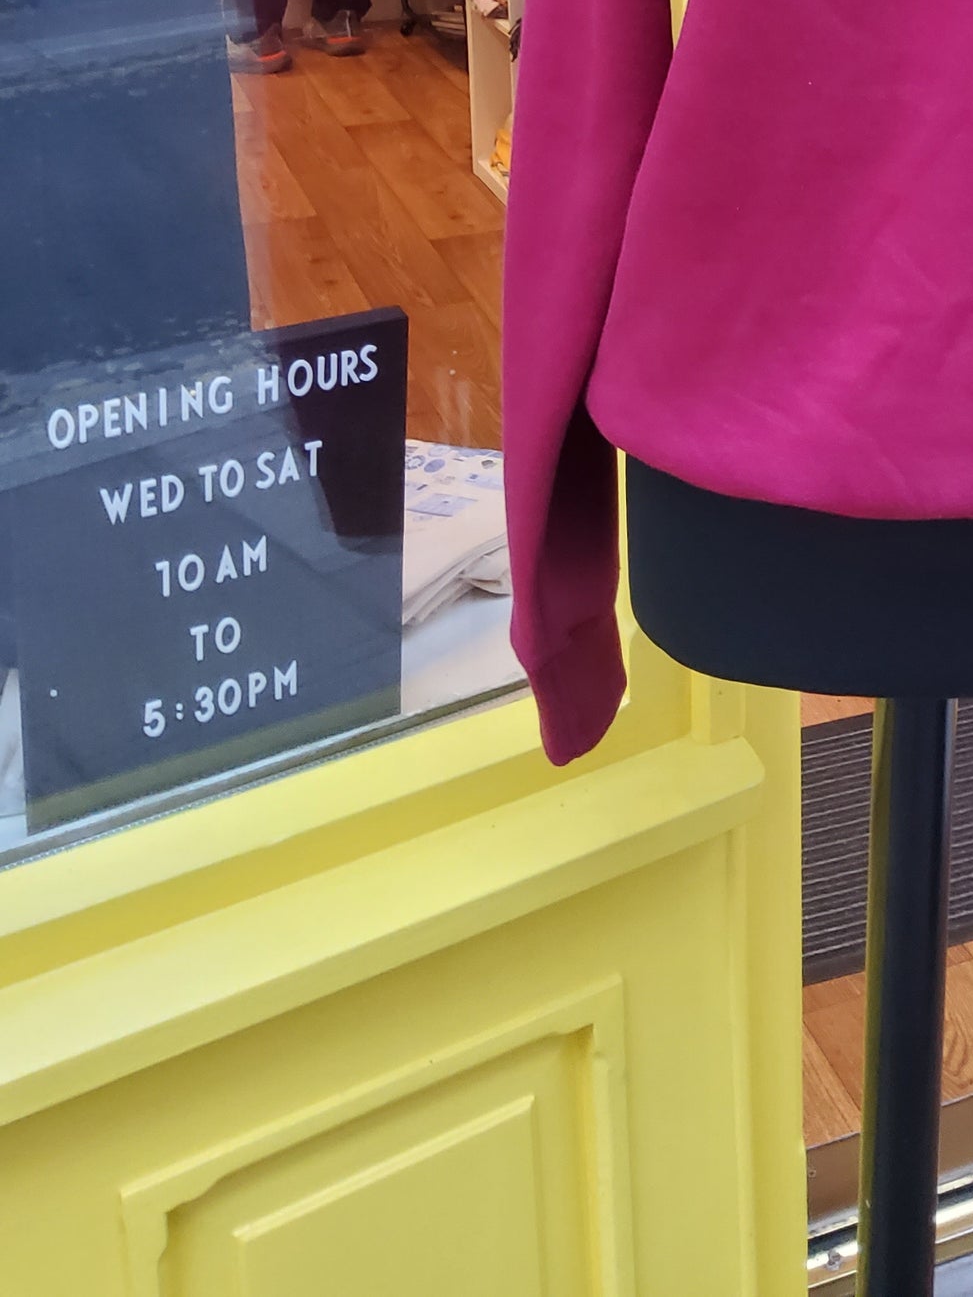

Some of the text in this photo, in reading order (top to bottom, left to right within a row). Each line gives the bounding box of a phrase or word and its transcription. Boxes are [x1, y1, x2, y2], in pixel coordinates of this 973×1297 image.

[48, 344, 379, 450] OPENING HOURS
[100, 440, 323, 525] WED TO SAT
[190, 617, 242, 662] TO
[143, 661, 298, 738] 5:30PM
